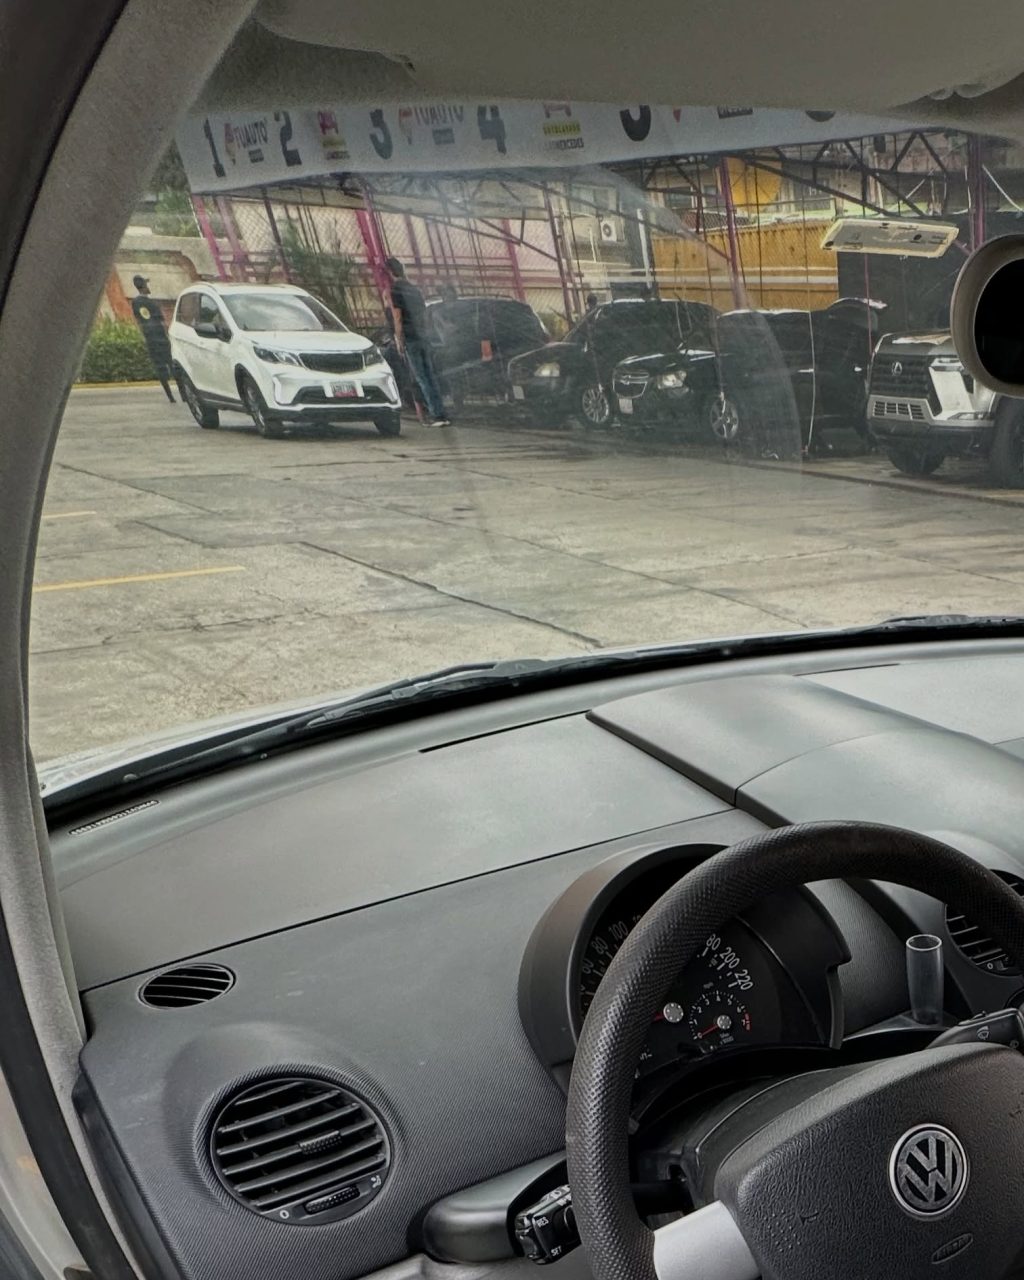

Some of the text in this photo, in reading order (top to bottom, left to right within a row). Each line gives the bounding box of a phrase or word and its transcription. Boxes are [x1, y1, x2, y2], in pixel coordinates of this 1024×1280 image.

[203, 118, 226, 178] 1
[274, 110, 302, 167] 2
[719, 946, 740, 969] 200
[734, 969, 754, 991] 220
[535, 1216, 550, 1229] RES
[550, 1245, 562, 1257] SET
